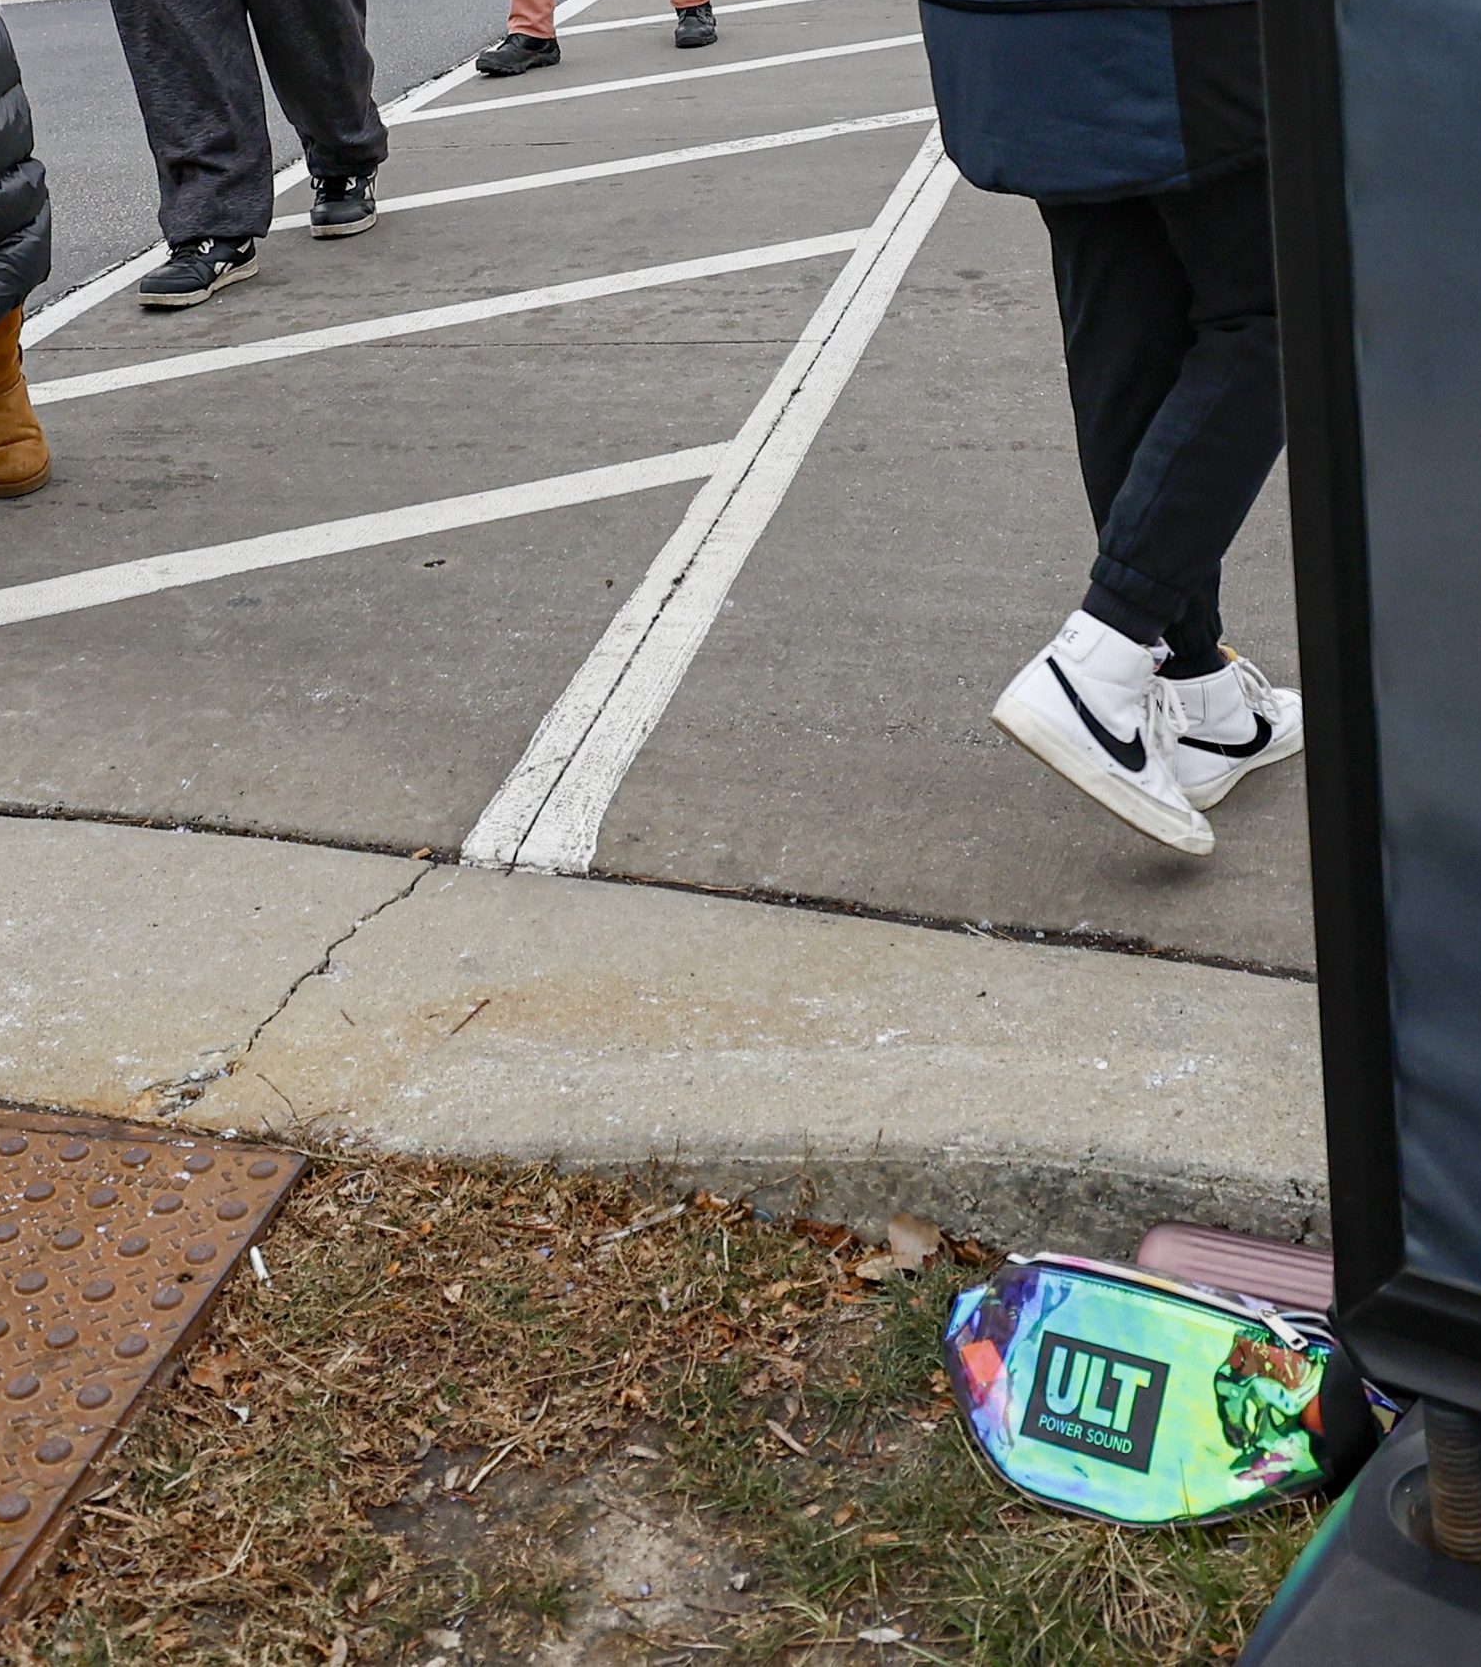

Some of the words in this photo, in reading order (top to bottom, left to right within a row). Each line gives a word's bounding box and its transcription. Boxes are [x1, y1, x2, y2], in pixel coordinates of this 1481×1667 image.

[1044, 1345, 1153, 1434] ULT
[1038, 1414, 1084, 1442] POWER
[1085, 1427, 1134, 1456] SOUND
